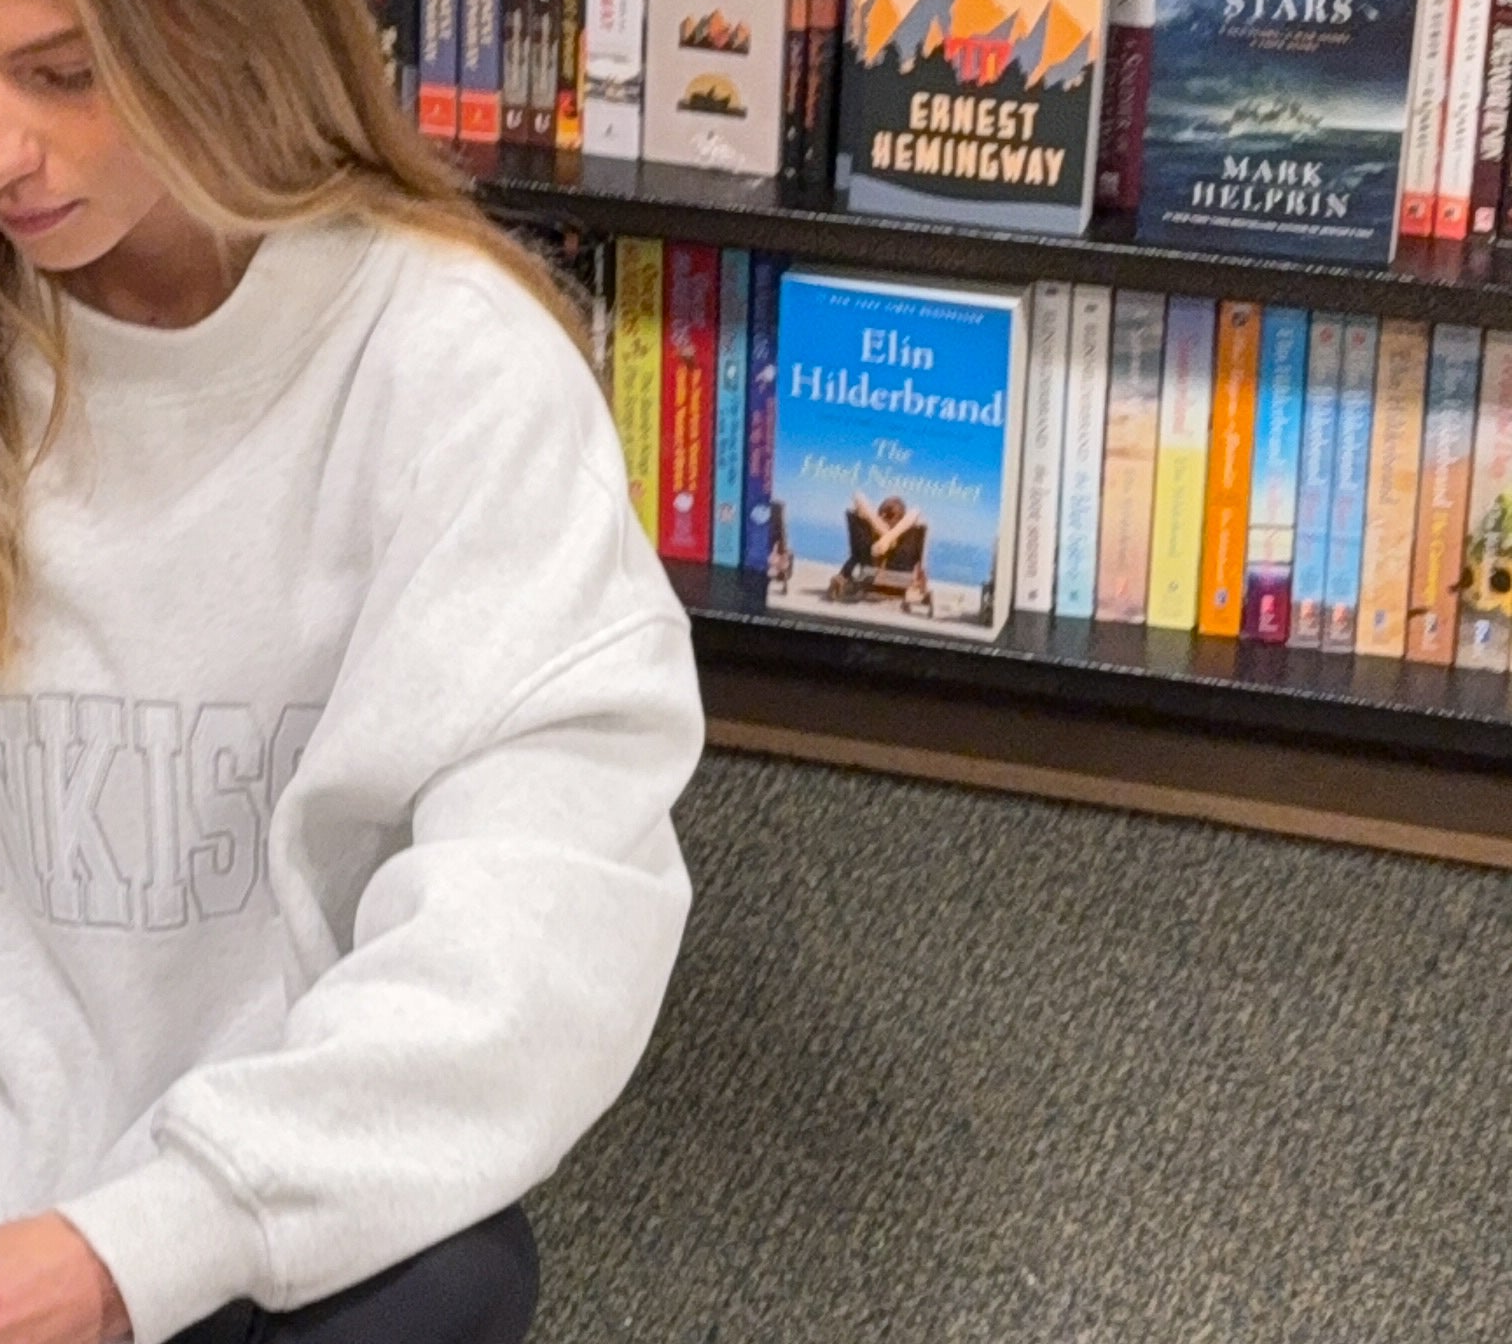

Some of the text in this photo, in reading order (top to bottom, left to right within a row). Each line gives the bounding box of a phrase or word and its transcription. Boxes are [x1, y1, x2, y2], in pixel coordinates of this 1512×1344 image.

[908, 91, 1040, 142] ERNEST
[871, 131, 1066, 188] HEMINGWAY
[1221, 157, 1323, 190] MARK
[1191, 182, 1350, 220] HELPRIN
[861, 328, 934, 373] Elin
[788, 361, 1006, 430] Hilderbrand
[798, 454, 984, 503] Hotel Nantucket
